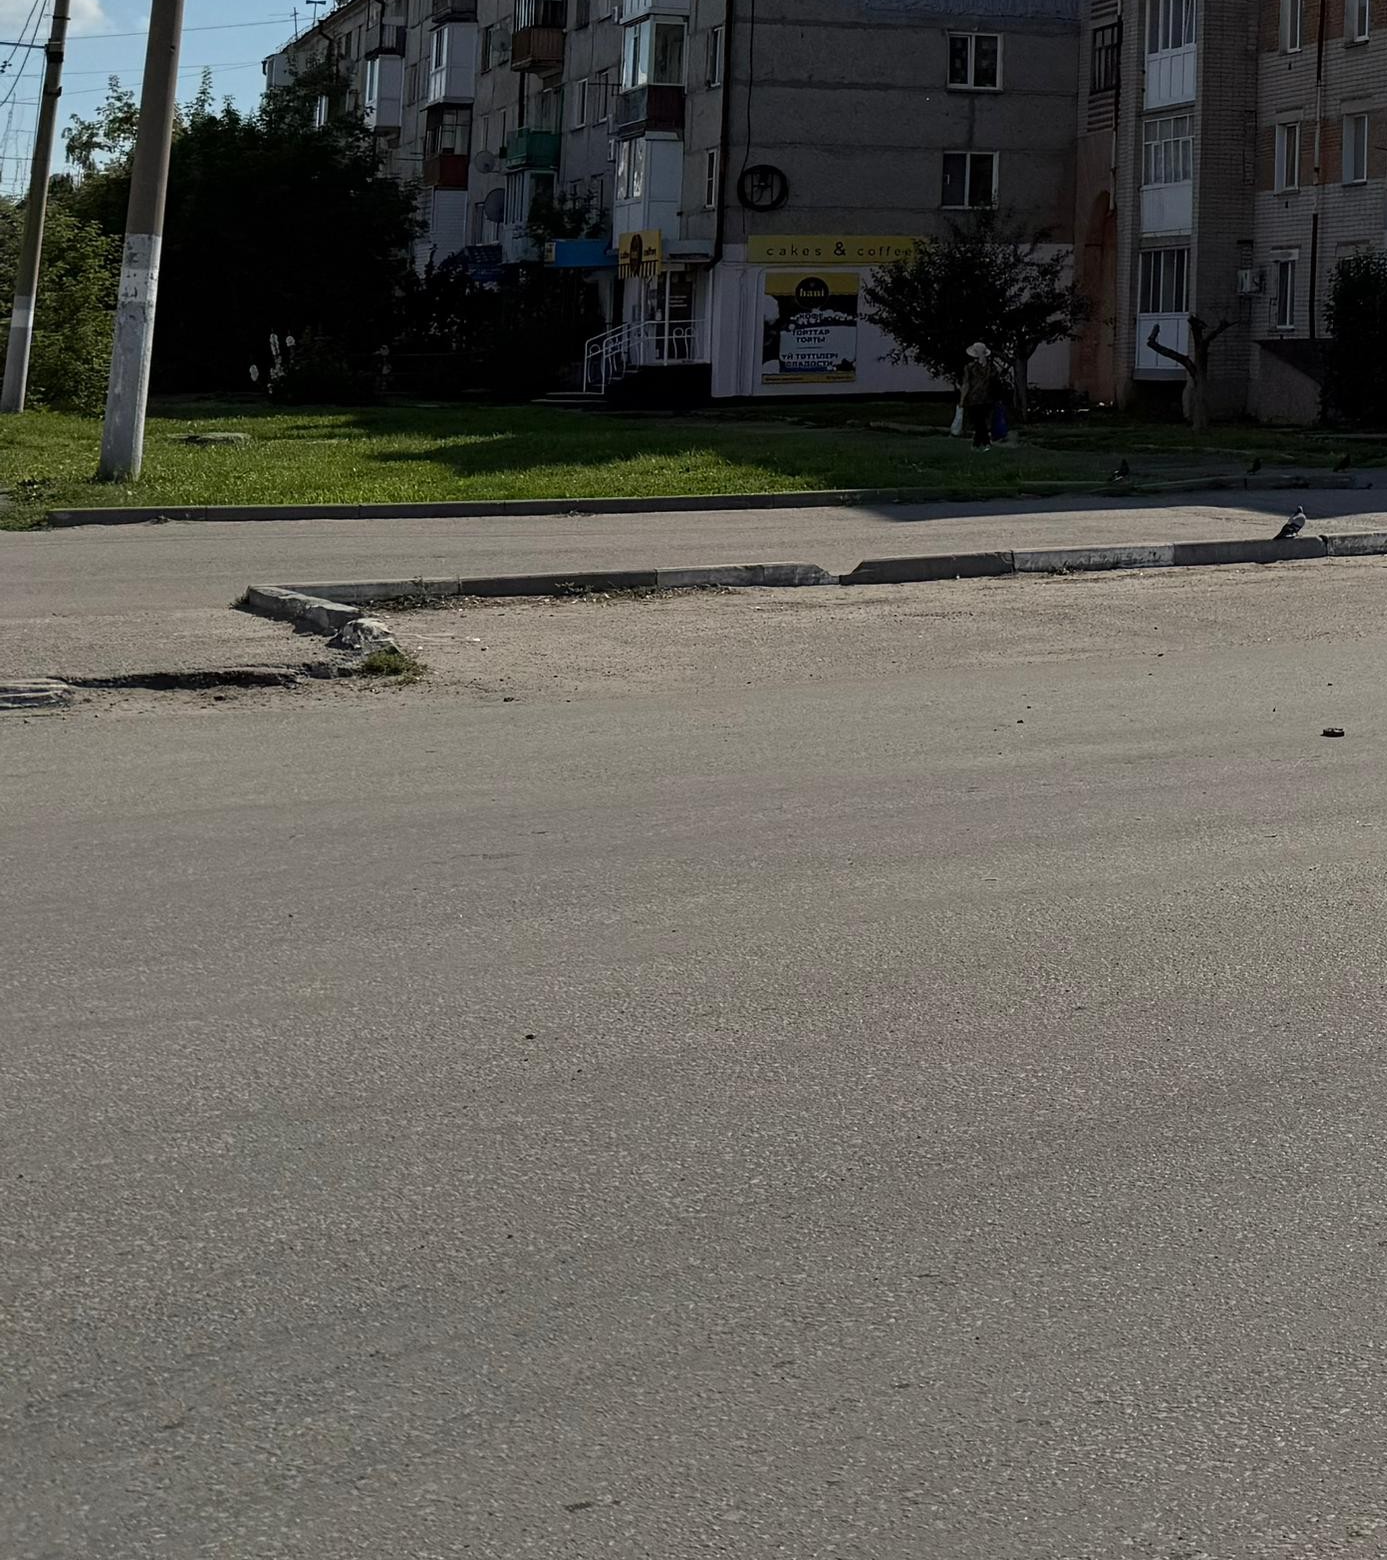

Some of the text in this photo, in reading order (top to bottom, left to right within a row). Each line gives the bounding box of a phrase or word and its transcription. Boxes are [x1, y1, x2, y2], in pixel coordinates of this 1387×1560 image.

[766, 241, 912, 258] cakes & coffee
